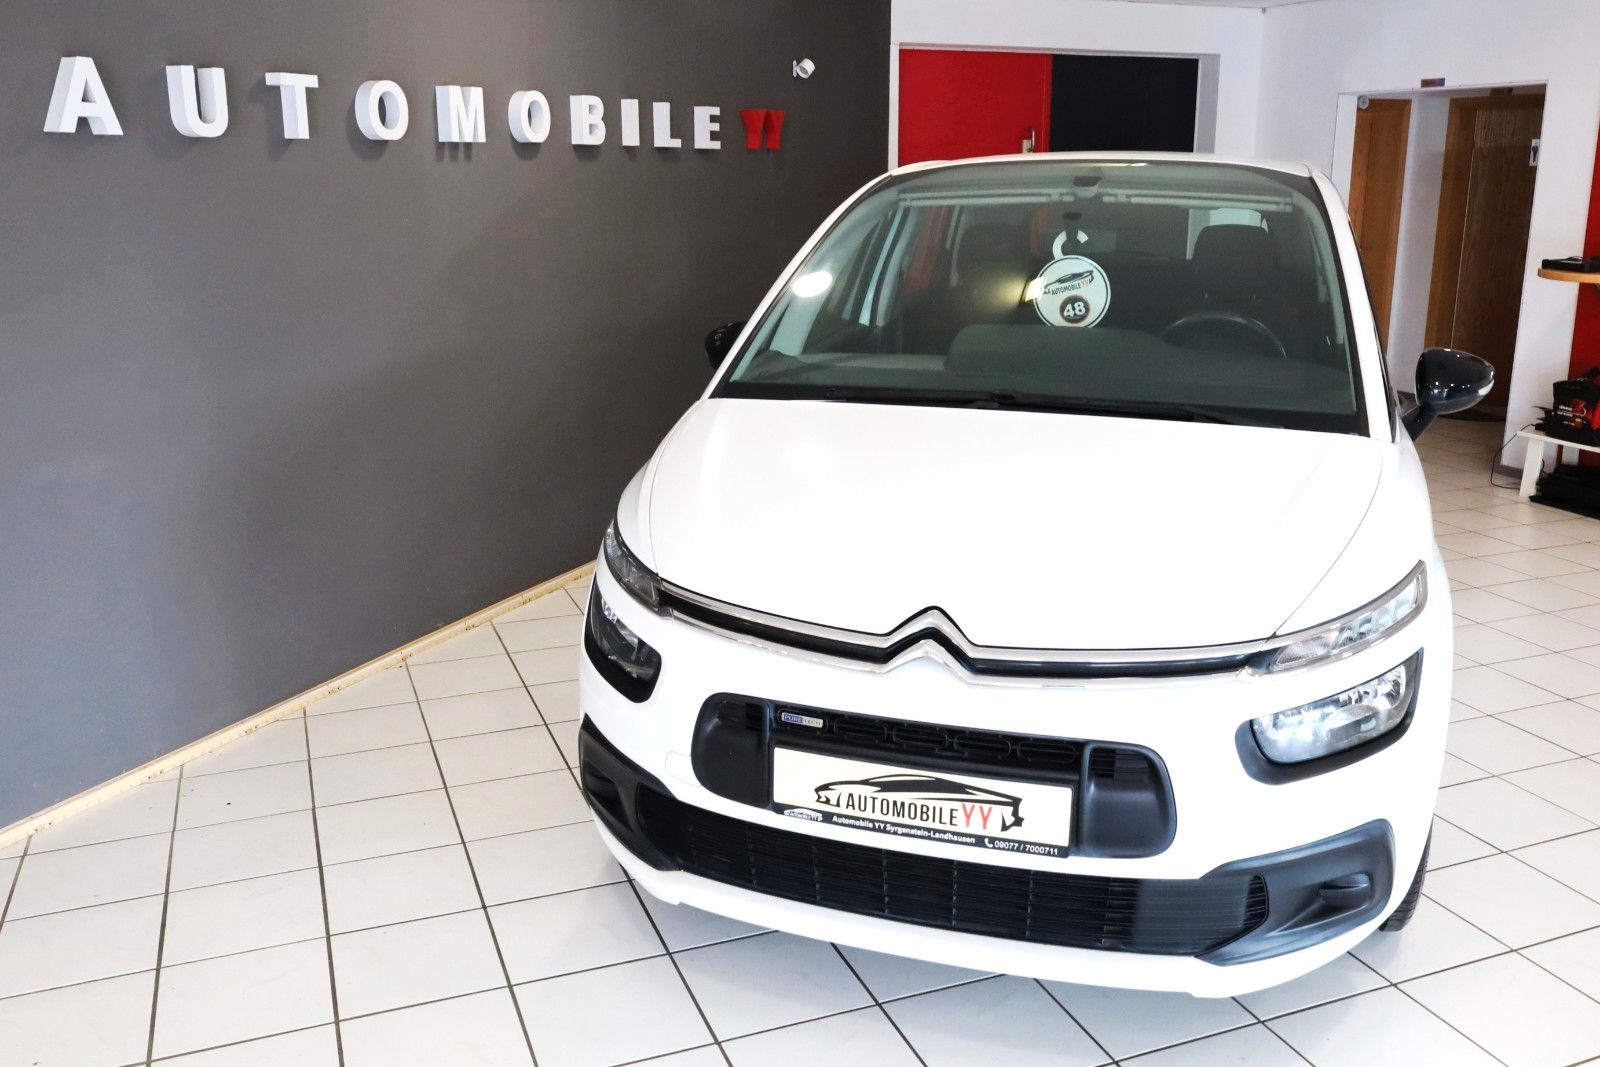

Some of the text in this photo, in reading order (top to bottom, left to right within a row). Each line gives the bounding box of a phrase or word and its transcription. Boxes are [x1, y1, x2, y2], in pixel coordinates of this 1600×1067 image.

[43, 56, 786, 151] AUTOMOBILE YY
[1051, 284, 1081, 295] AUTOMOBILE
[1063, 302, 1086, 318] 48
[845, 792, 993, 830] AUTOMOBILE YY
[832, 815, 976, 844] Automobile YY Syrgenstein-Landhausen
[994, 840, 1019, 850] 09077
[1025, 844, 1058, 855] 7000711
